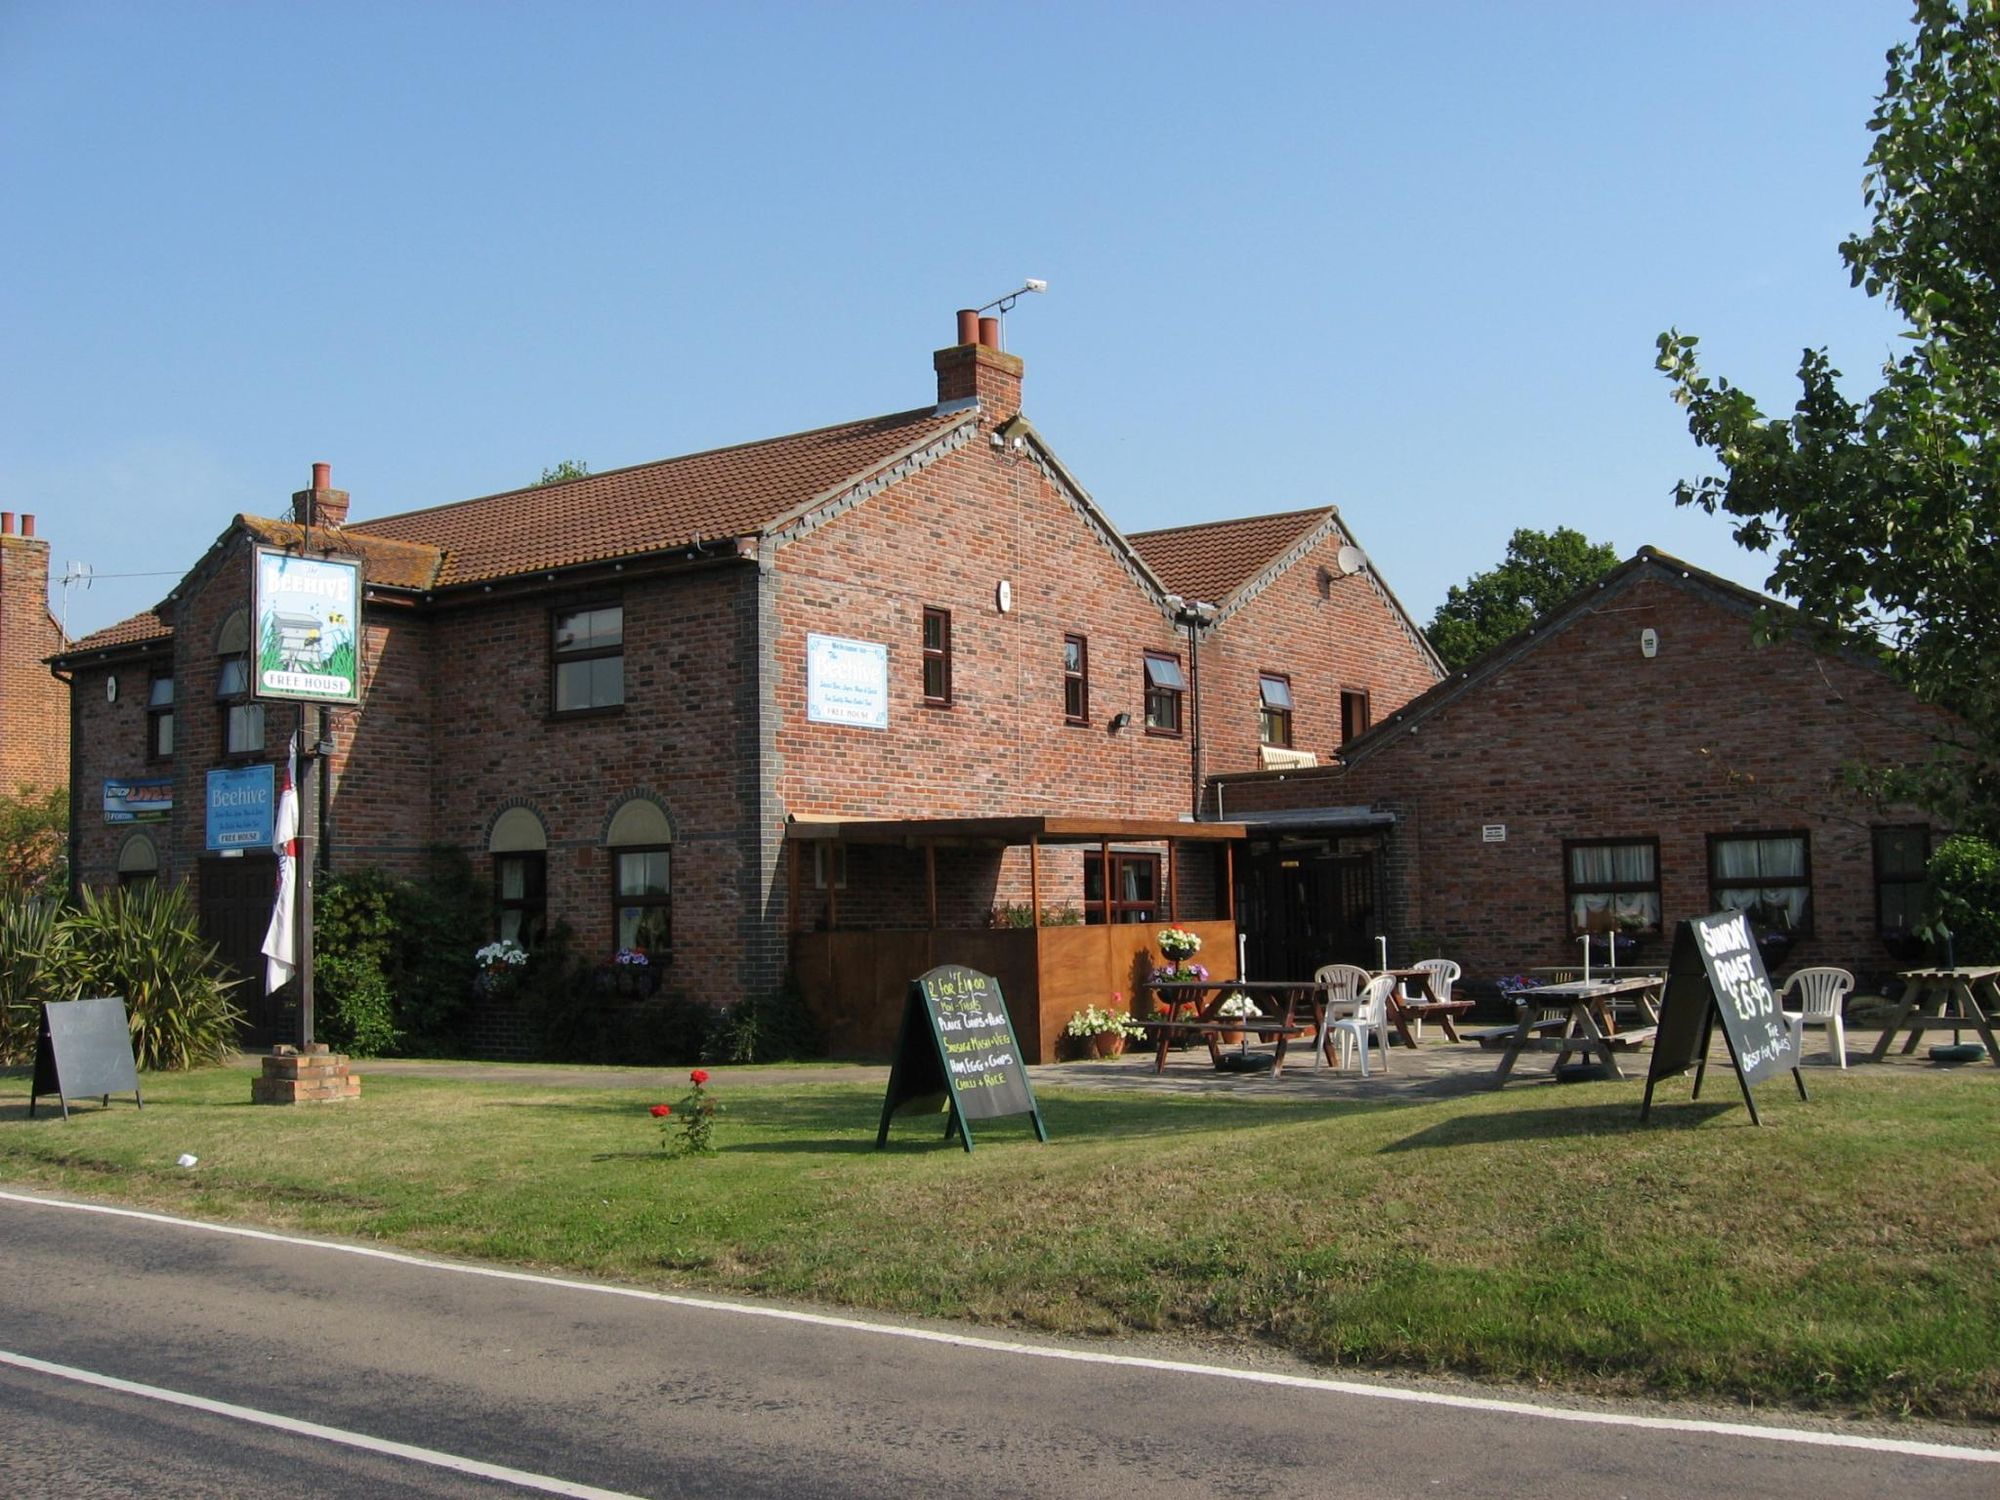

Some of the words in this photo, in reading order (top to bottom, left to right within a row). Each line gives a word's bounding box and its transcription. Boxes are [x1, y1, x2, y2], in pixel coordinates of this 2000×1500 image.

[267, 568, 348, 601] BEEHIVE
[270, 675, 299, 686] FREE
[304, 678, 346, 690] HOUSE
[212, 786, 266, 808] Beehive
[221, 833, 236, 842] FREE
[1700, 915, 1750, 957] SUNDAY
[1714, 954, 1755, 996] ROAST
[984, 1073, 1006, 1087] RICE
